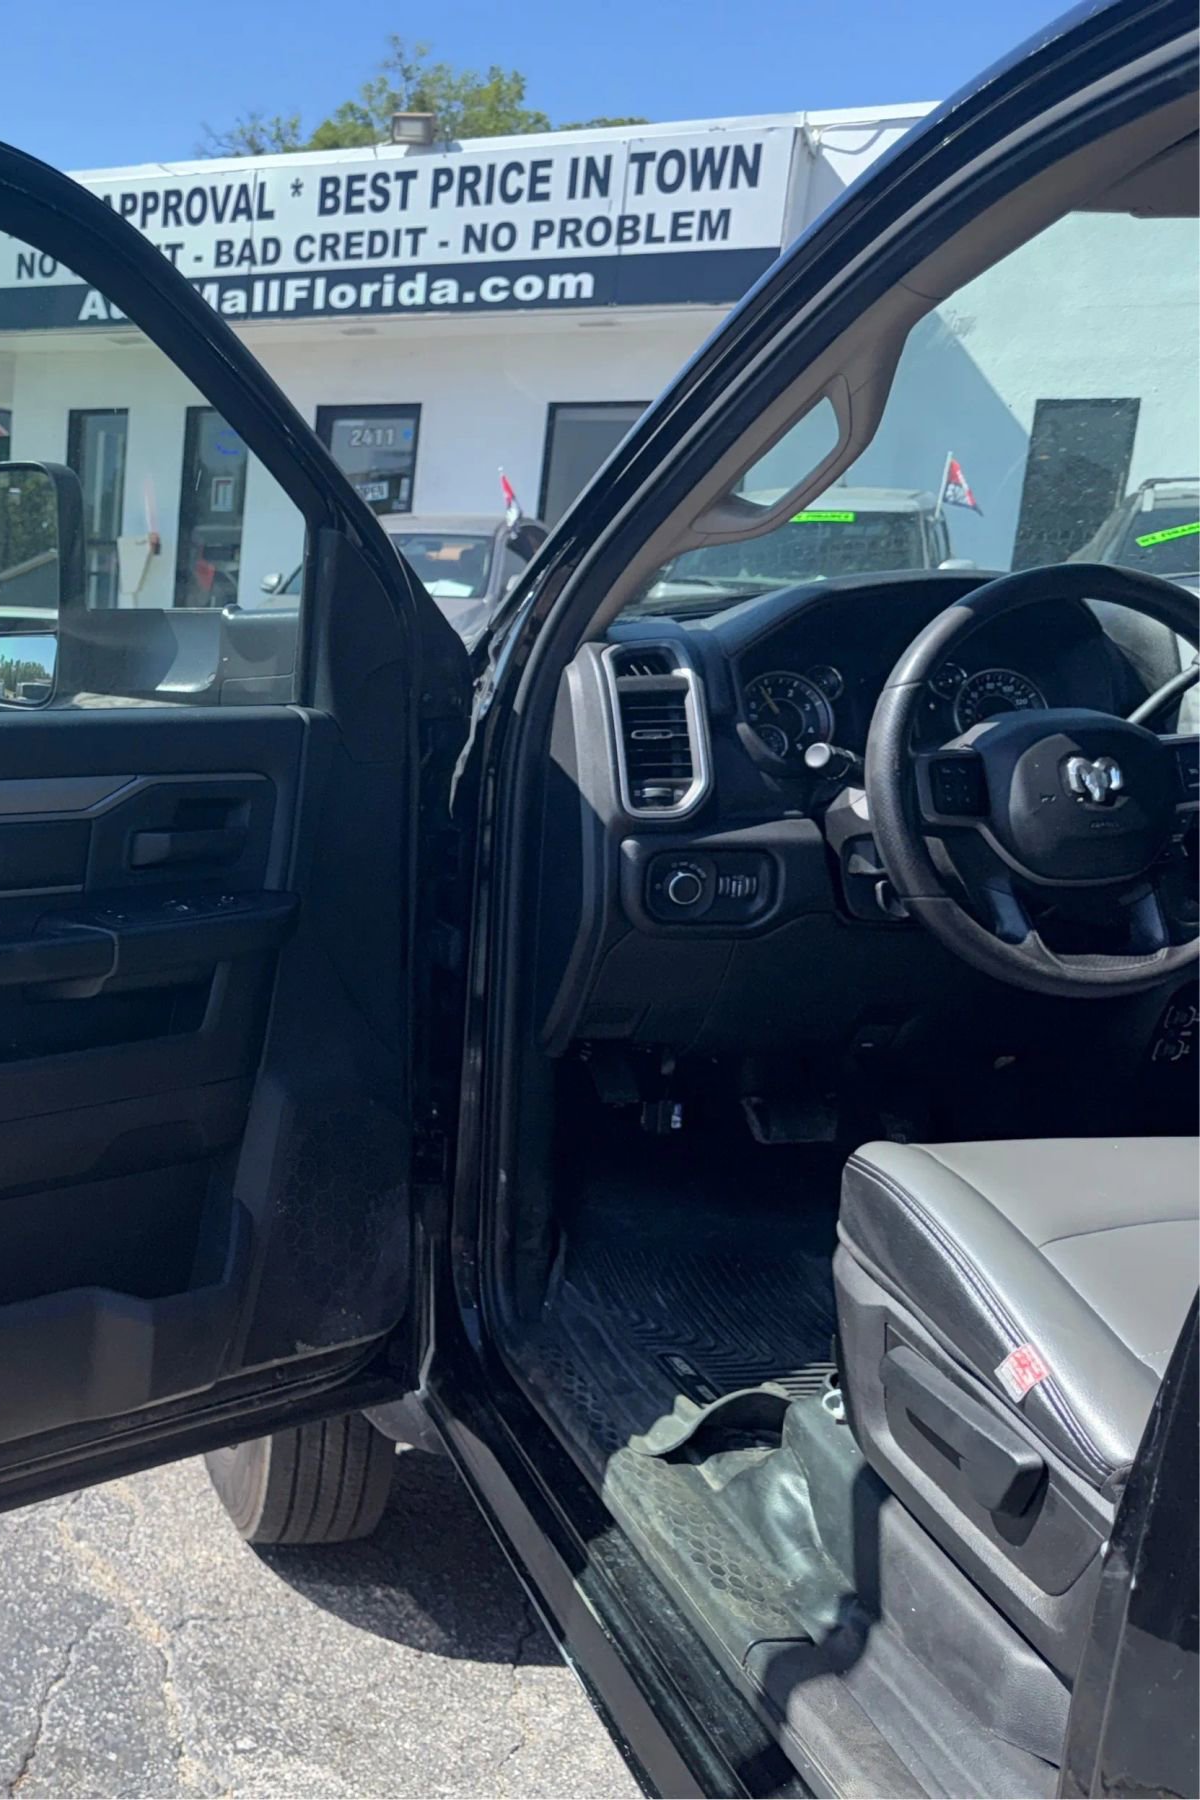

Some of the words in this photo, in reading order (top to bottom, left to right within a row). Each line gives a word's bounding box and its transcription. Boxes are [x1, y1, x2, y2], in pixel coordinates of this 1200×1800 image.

[317, 169, 418, 217] BEST
[429, 158, 553, 209] PRICE
[567, 154, 613, 200] IN
[628, 143, 763, 196] TOWN
[16, 252, 58, 280] NO
[213, 236, 282, 268] BAD
[293, 226, 428, 264] CREDIT
[462, 221, 518, 255] NO
[530, 207, 732, 251] PROBLEM
[350, 428, 395, 447] 2411
